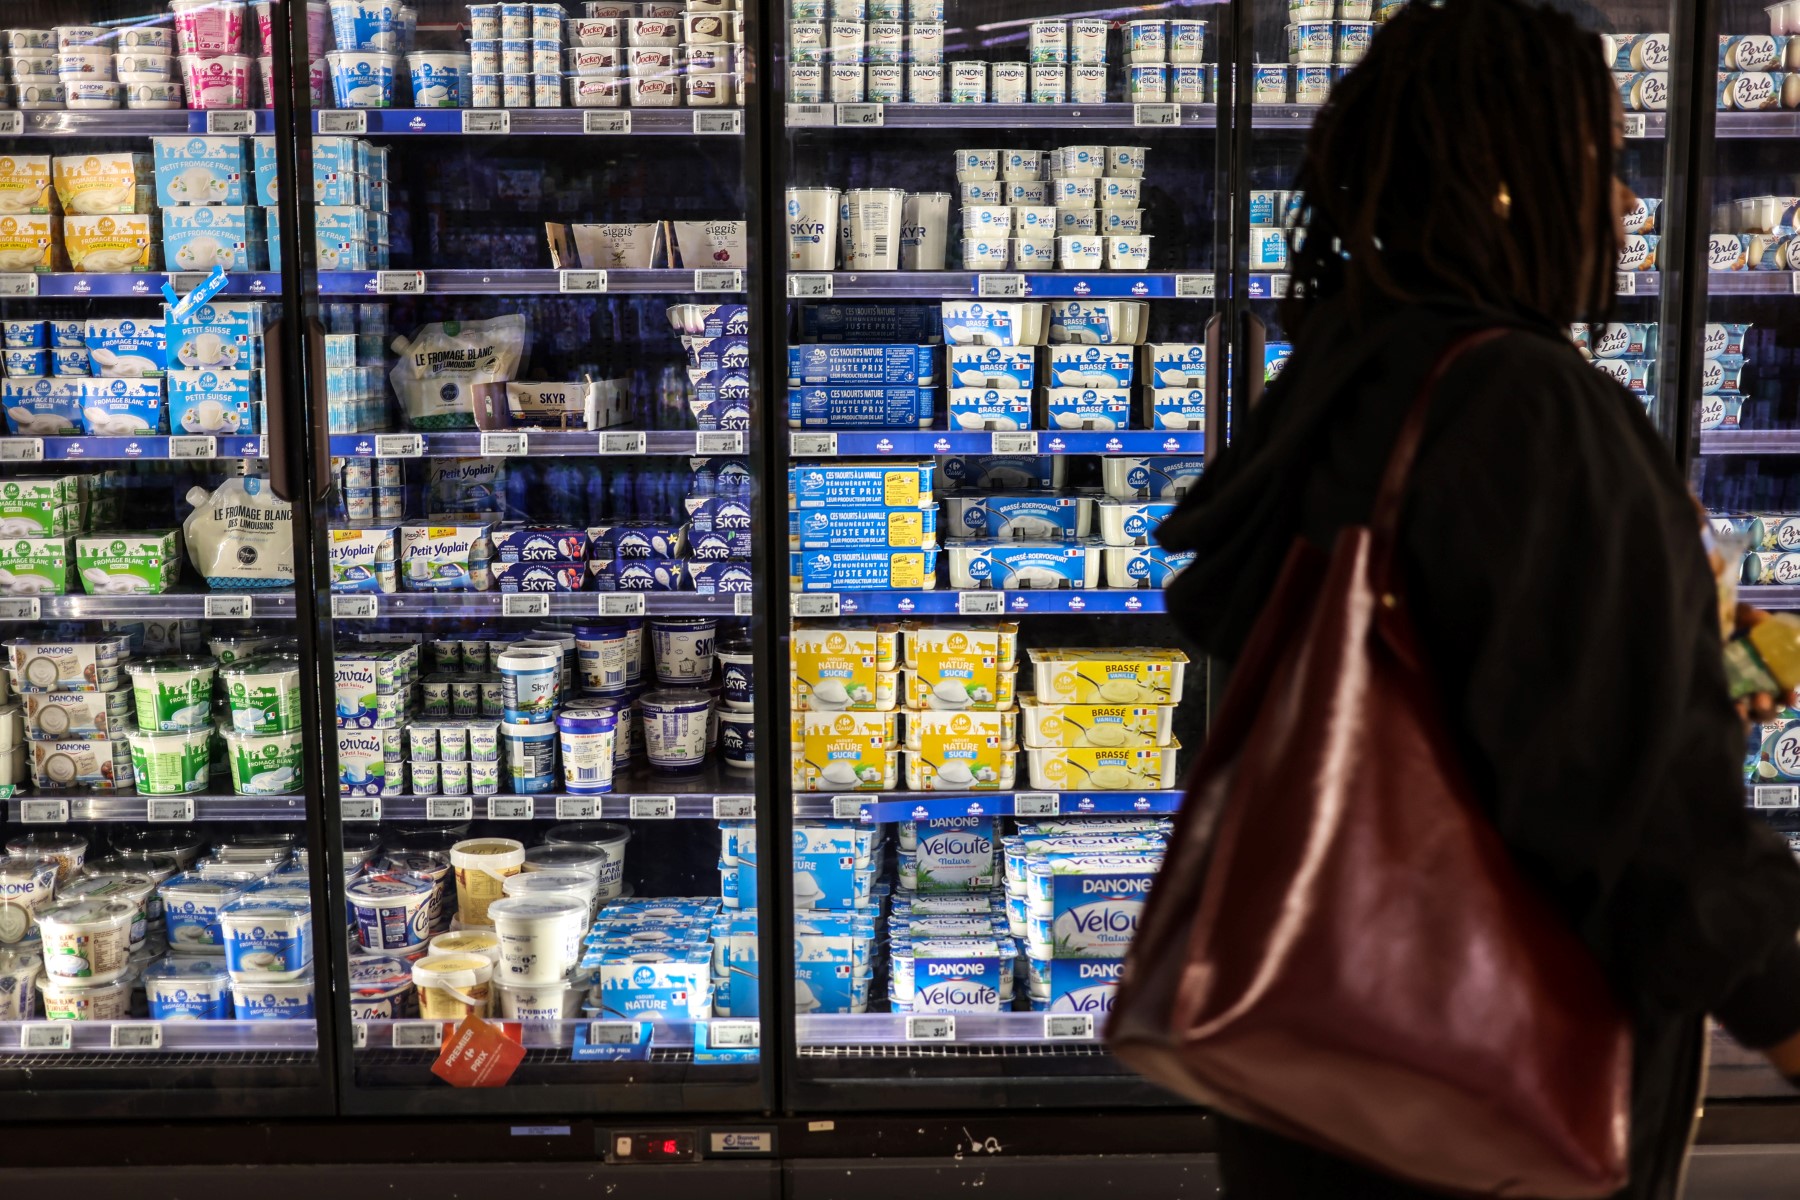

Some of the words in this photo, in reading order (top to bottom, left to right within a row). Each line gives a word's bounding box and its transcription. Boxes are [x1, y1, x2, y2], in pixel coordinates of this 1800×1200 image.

[640, 24, 664, 35] Jockey
[1036, 26, 1064, 34] DANONE
[1739, 40, 1773, 56] Perle
[578, 54, 601, 66] Jockey
[637, 54, 660, 65] Jockey
[1747, 54, 1772, 66] Lait
[956, 69, 984, 77] DANONE
[641, 82, 664, 93] Jockey
[1738, 78, 1772, 94] Perle
[1745, 90, 1770, 102] Lait
[160, 162, 180, 173] PETIT
[180, 160, 214, 168] FROMAGE
[214, 162, 235, 172] FRAIS
[790, 224, 824, 234] SKYR
[81, 236, 107, 244] FROMAGE
[108, 236, 133, 244] BLANC
[168, 232, 186, 242] PETIT
[188, 230, 221, 238] FROMAGE
[222, 232, 240, 241] FRAIS
[1709, 239, 1739, 254] Perle
[1620, 253, 1644, 265] Lait
[1713, 252, 1737, 264] Lait
[966, 319, 989, 327] BRASSÉ
[182, 327, 203, 335] PETIT
[204, 326, 231, 335] SUISSE
[102, 338, 132, 348] FROMAGE
[133, 339, 153, 347] BLANC
[416, 354, 426, 366] LE
[428, 350, 465, 365] FROMAGE
[468, 346, 493, 358] BLANC
[830, 348, 840, 356] CES
[841, 348, 862, 356] YAOURTS
[863, 348, 883, 356] NATURE
[443, 361, 476, 369] LIMOUSINS
[980, 363, 1007, 371] BRASSÉ
[1079, 363, 1106, 371] BRASSÉ
[94, 397, 124, 406] FROMAGE
[124, 398, 144, 406] BLANC
[206, 394, 232, 402] SUISSE
[540, 394, 566, 404] SKYR
[978, 405, 1005, 413] BRASSÉ
[1000, 502, 1060, 513] BRASSÉ-ROERYOGHURT
[214, 508, 224, 521] LE
[226, 505, 262, 520] FROMAGE
[264, 510, 292, 521] BLANC
[228, 518, 238, 528] DES
[240, 519, 274, 530] LIMOUSINS
[716, 518, 750, 528] SKYR
[340, 545, 374, 559] Yoplait
[410, 545, 433, 557] Petit
[434, 542, 469, 556] Yoplait
[697, 549, 730, 559] SKYR
[523, 550, 557, 560] SKYR
[1005, 552, 1068, 564] BRASSÉ-ROERYOGHURT
[29, 558, 49, 566] BLANC
[94, 558, 124, 566] FROMAGE
[834, 569, 862, 577] JUSTE
[866, 569, 888, 577] PRIX
[522, 581, 556, 591] SKYR
[620, 579, 654, 588] SKYR
[719, 582, 752, 592] SKYR
[818, 662, 854, 670] NATURE
[939, 661, 974, 670] NATURE
[1105, 664, 1140, 673] BRASSÉ
[335, 670, 373, 683] ervais
[824, 670, 848, 678] SUCRÉ
[944, 670, 968, 678] SUCRÉ
[531, 682, 549, 693] Skyr
[726, 679, 747, 690] SKYR
[1091, 708, 1126, 717] BRASSÉ
[340, 739, 380, 751] ervais
[827, 743, 862, 751] NATURE
[943, 743, 978, 751] NATURE
[832, 750, 856, 759] SUCRÉ
[948, 750, 972, 759] SUCRÉ
[1095, 750, 1130, 759] BRASSÉ
[919, 836, 990, 855] Velouté
[1083, 878, 1153, 893] DANONE
[928, 964, 984, 975] DANONE
[918, 984, 996, 1006] Velouté
[625, 1000, 667, 1010] NATURE
[445, 1029, 474, 1067] PREMIER
[470, 1050, 488, 1072] PRIX
